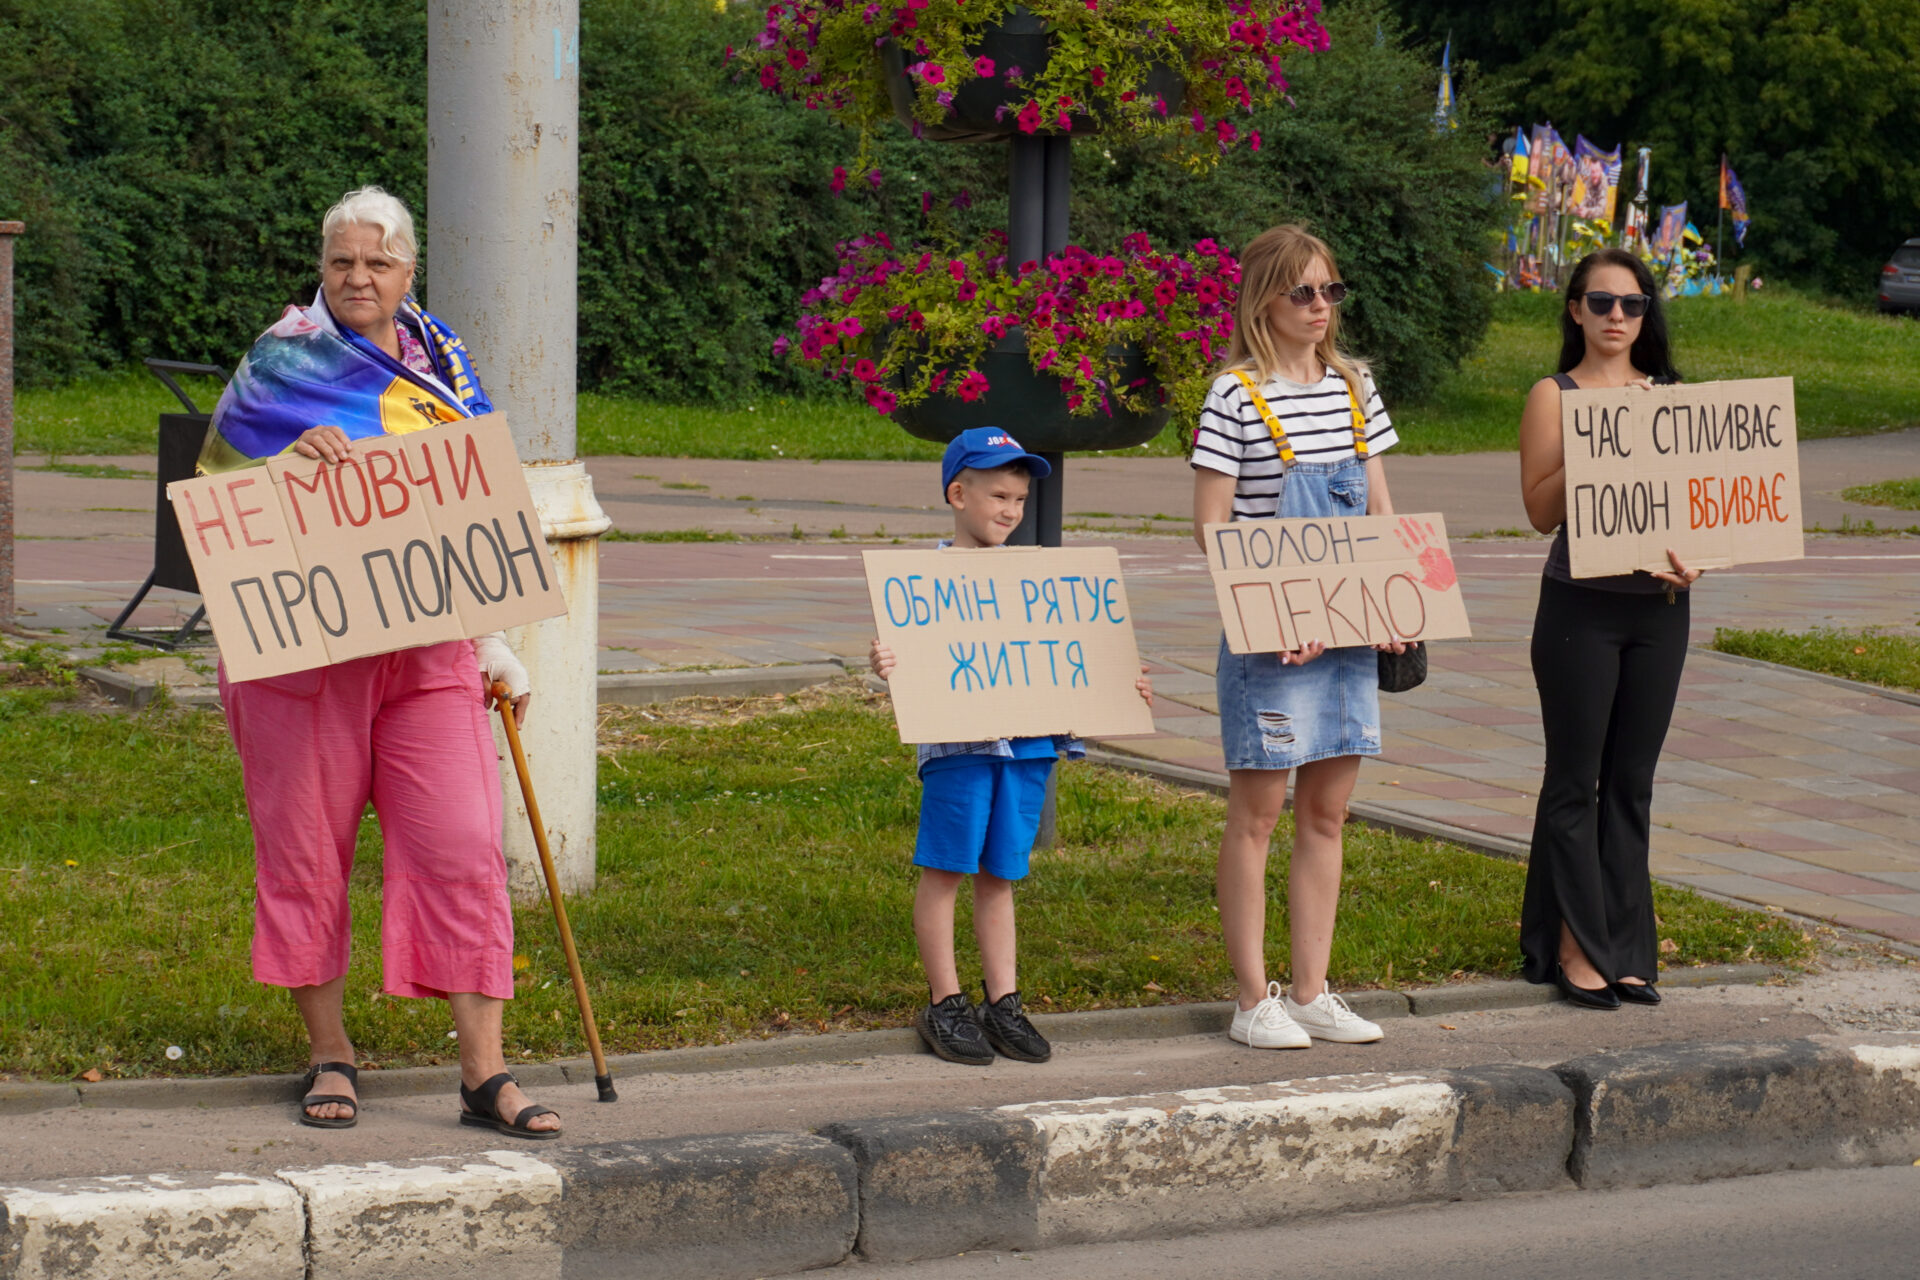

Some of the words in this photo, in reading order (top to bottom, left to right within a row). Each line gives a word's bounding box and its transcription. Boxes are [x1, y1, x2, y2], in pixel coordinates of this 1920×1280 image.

[1575, 405, 1631, 458] ЧАС
[1652, 403, 1782, 455] СПЛИВАЄ
[183, 478, 274, 556] НЕ
[283, 433, 491, 535] МОВЧИ
[1575, 480, 1670, 538] ПОЛОН
[1688, 472, 1789, 530] ВБИВАЄ
[230, 565, 349, 655] ПРО
[362, 510, 549, 629] ПОЛОН
[1020, 576, 1125, 624] РЯТУЄ
[1231, 573, 1425, 651] ПЕКЛО
[948, 640, 1089, 692] ЖИТТЯ
